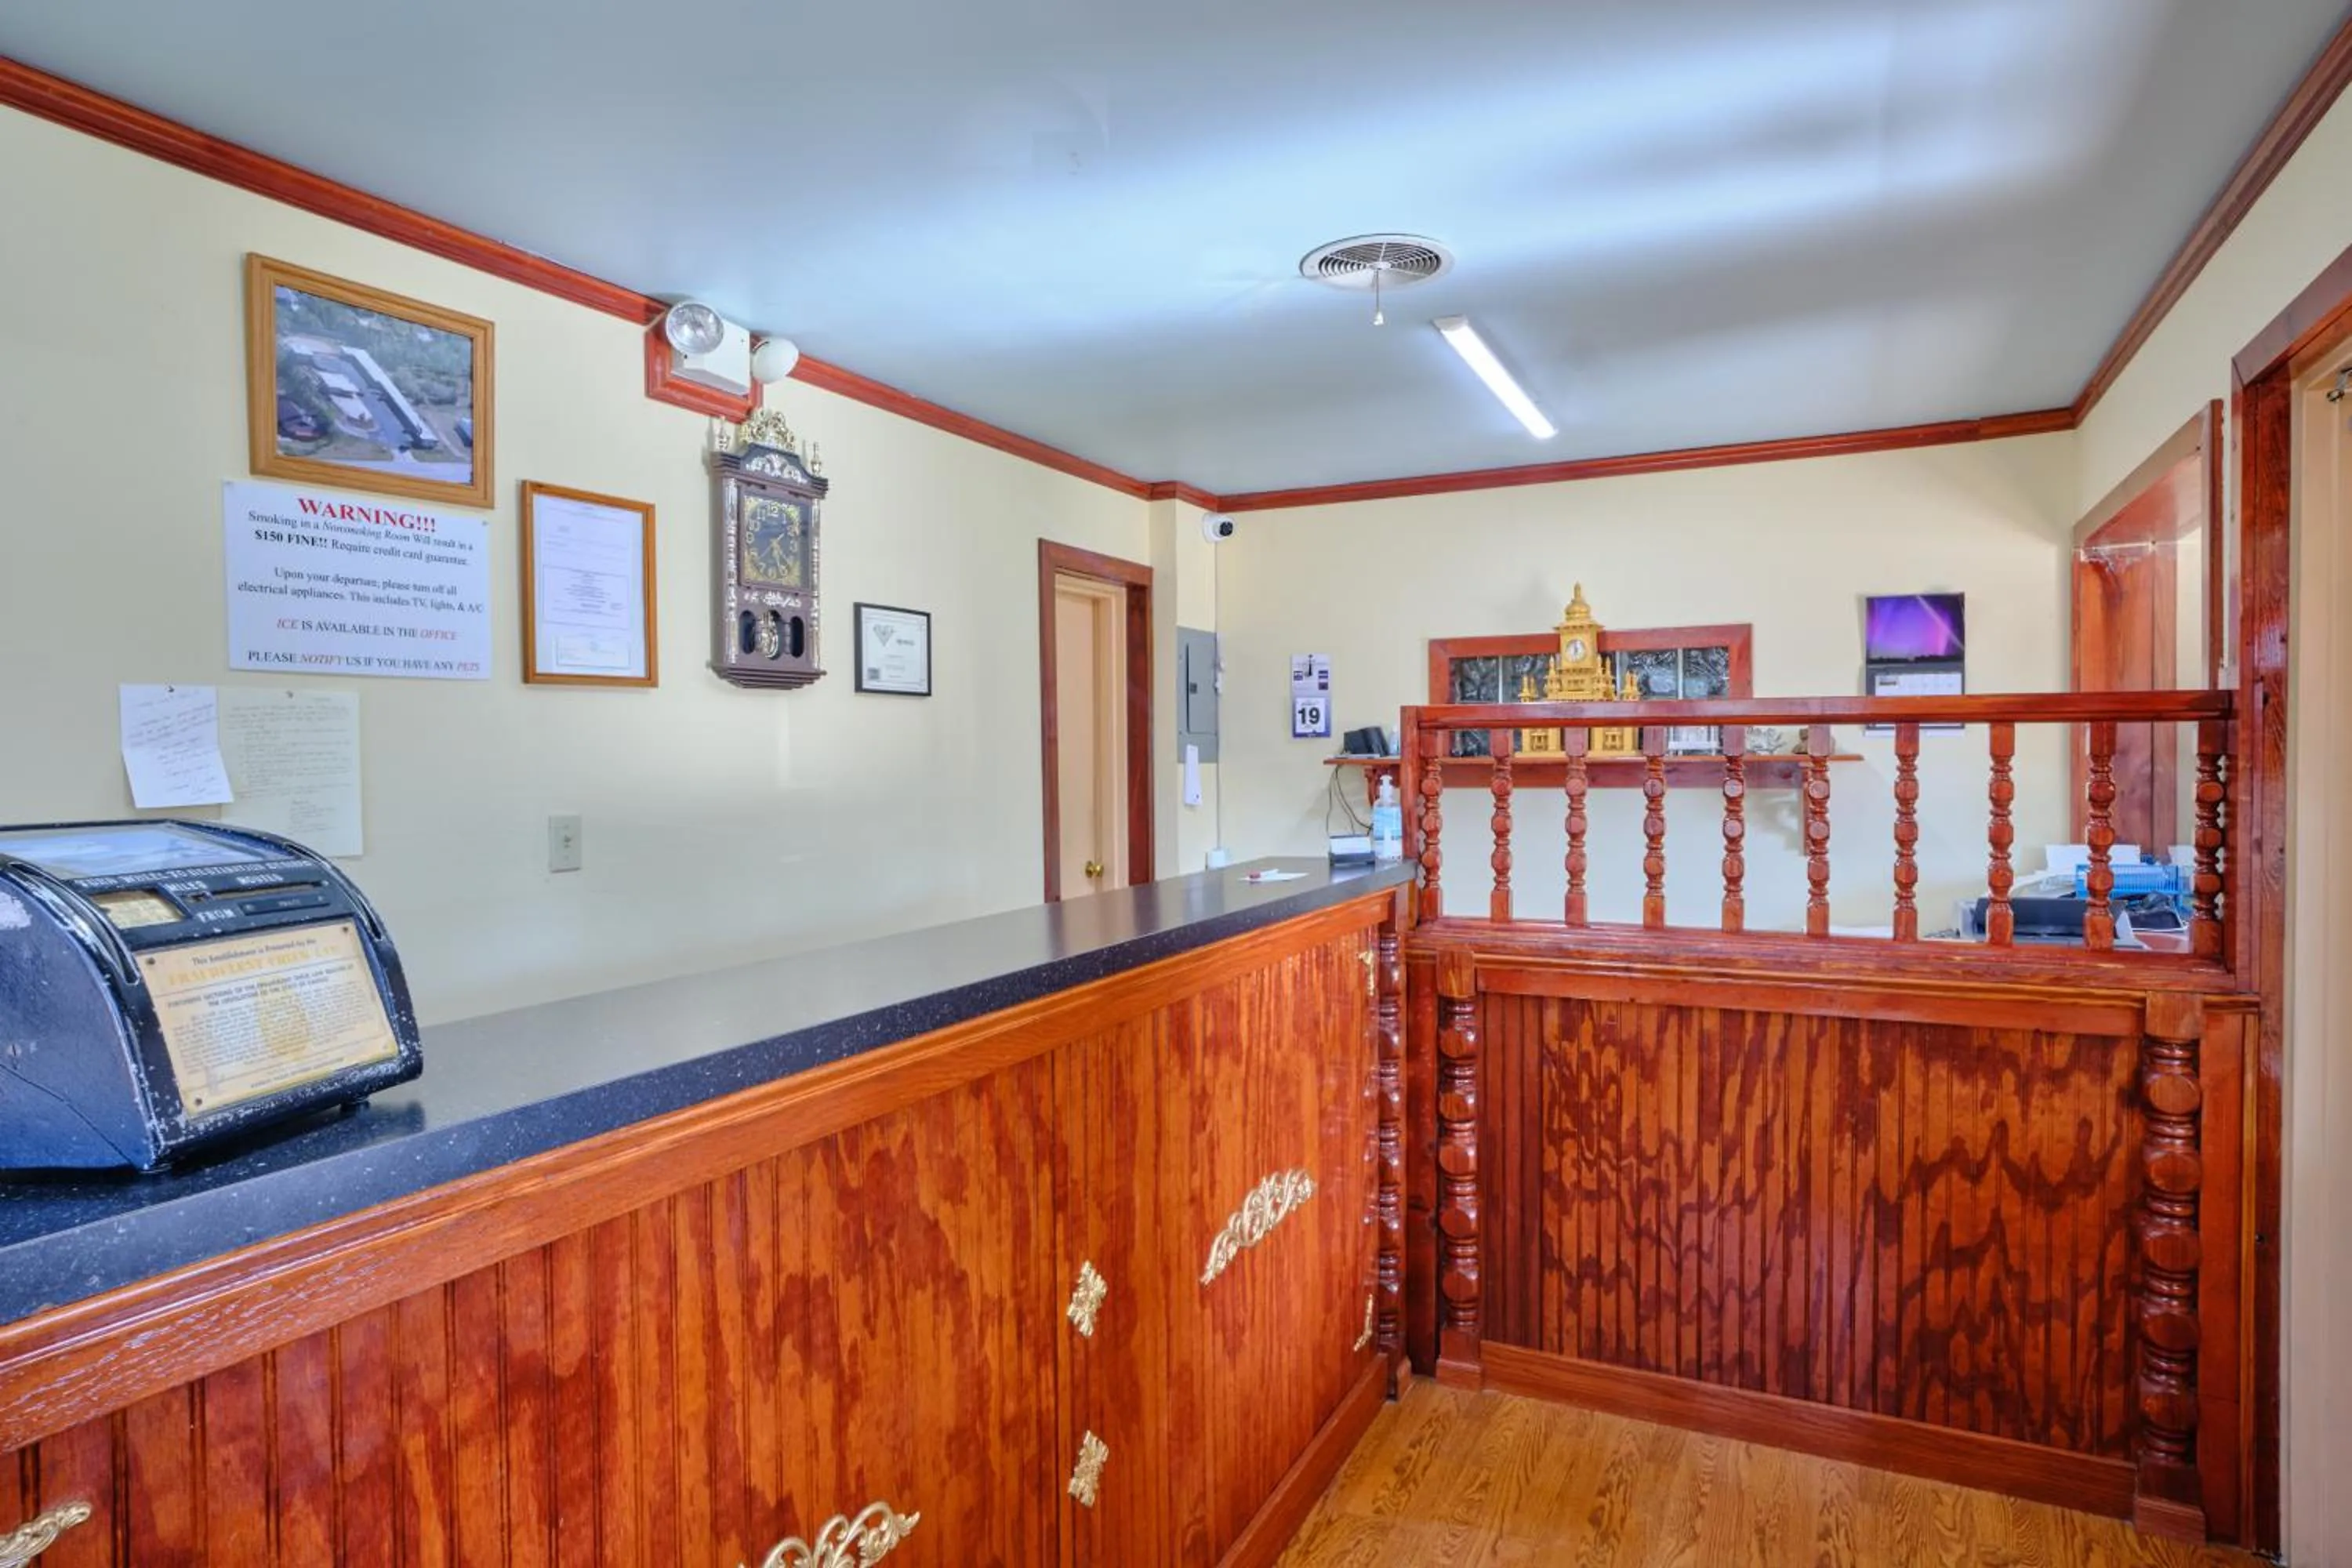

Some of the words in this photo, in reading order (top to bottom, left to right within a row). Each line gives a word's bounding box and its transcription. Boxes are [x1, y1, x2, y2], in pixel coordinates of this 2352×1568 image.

[249, 510, 297, 529] Smoking
[301, 520, 311, 528] in
[384, 529, 410, 542] Room
[412, 533, 430, 546] Will
[297, 498, 435, 532] WARNING!!!
[254, 528, 283, 543] $150
[288, 532, 327, 549] FINE!!
[331, 539, 371, 554] Require
[372, 545, 401, 558] credit
[402, 550, 423, 561] card
[238, 581, 288, 596] electrical
[350, 590, 370, 603] This
[372, 593, 410, 607] includes
[457, 601, 465, 612] &
[274, 566, 304, 581] Upon
[306, 573, 330, 583] your
[382, 579, 410, 591] please
[412, 582, 430, 593] turn
[432, 583, 445, 594] off
[447, 585, 457, 597] all
[277, 618, 299, 630] ICE
[301, 620, 313, 631] IS
[315, 620, 381, 636] AVAILABLE
[383, 626, 394, 637] IN
[396, 626, 418, 639] THE
[419, 628, 459, 641] OFFICE
[248, 650, 298, 663] PLEASE
[299, 653, 341, 666] NOTIFY
[345, 656, 361, 666] US
[364, 656, 374, 666] IF
[376, 658, 402, 668] YOU
[403, 659, 430, 670] HAVE
[433, 661, 455, 672] ANY
[1298, 706, 1320, 724] 19
[198, 909, 235, 923] FROM
